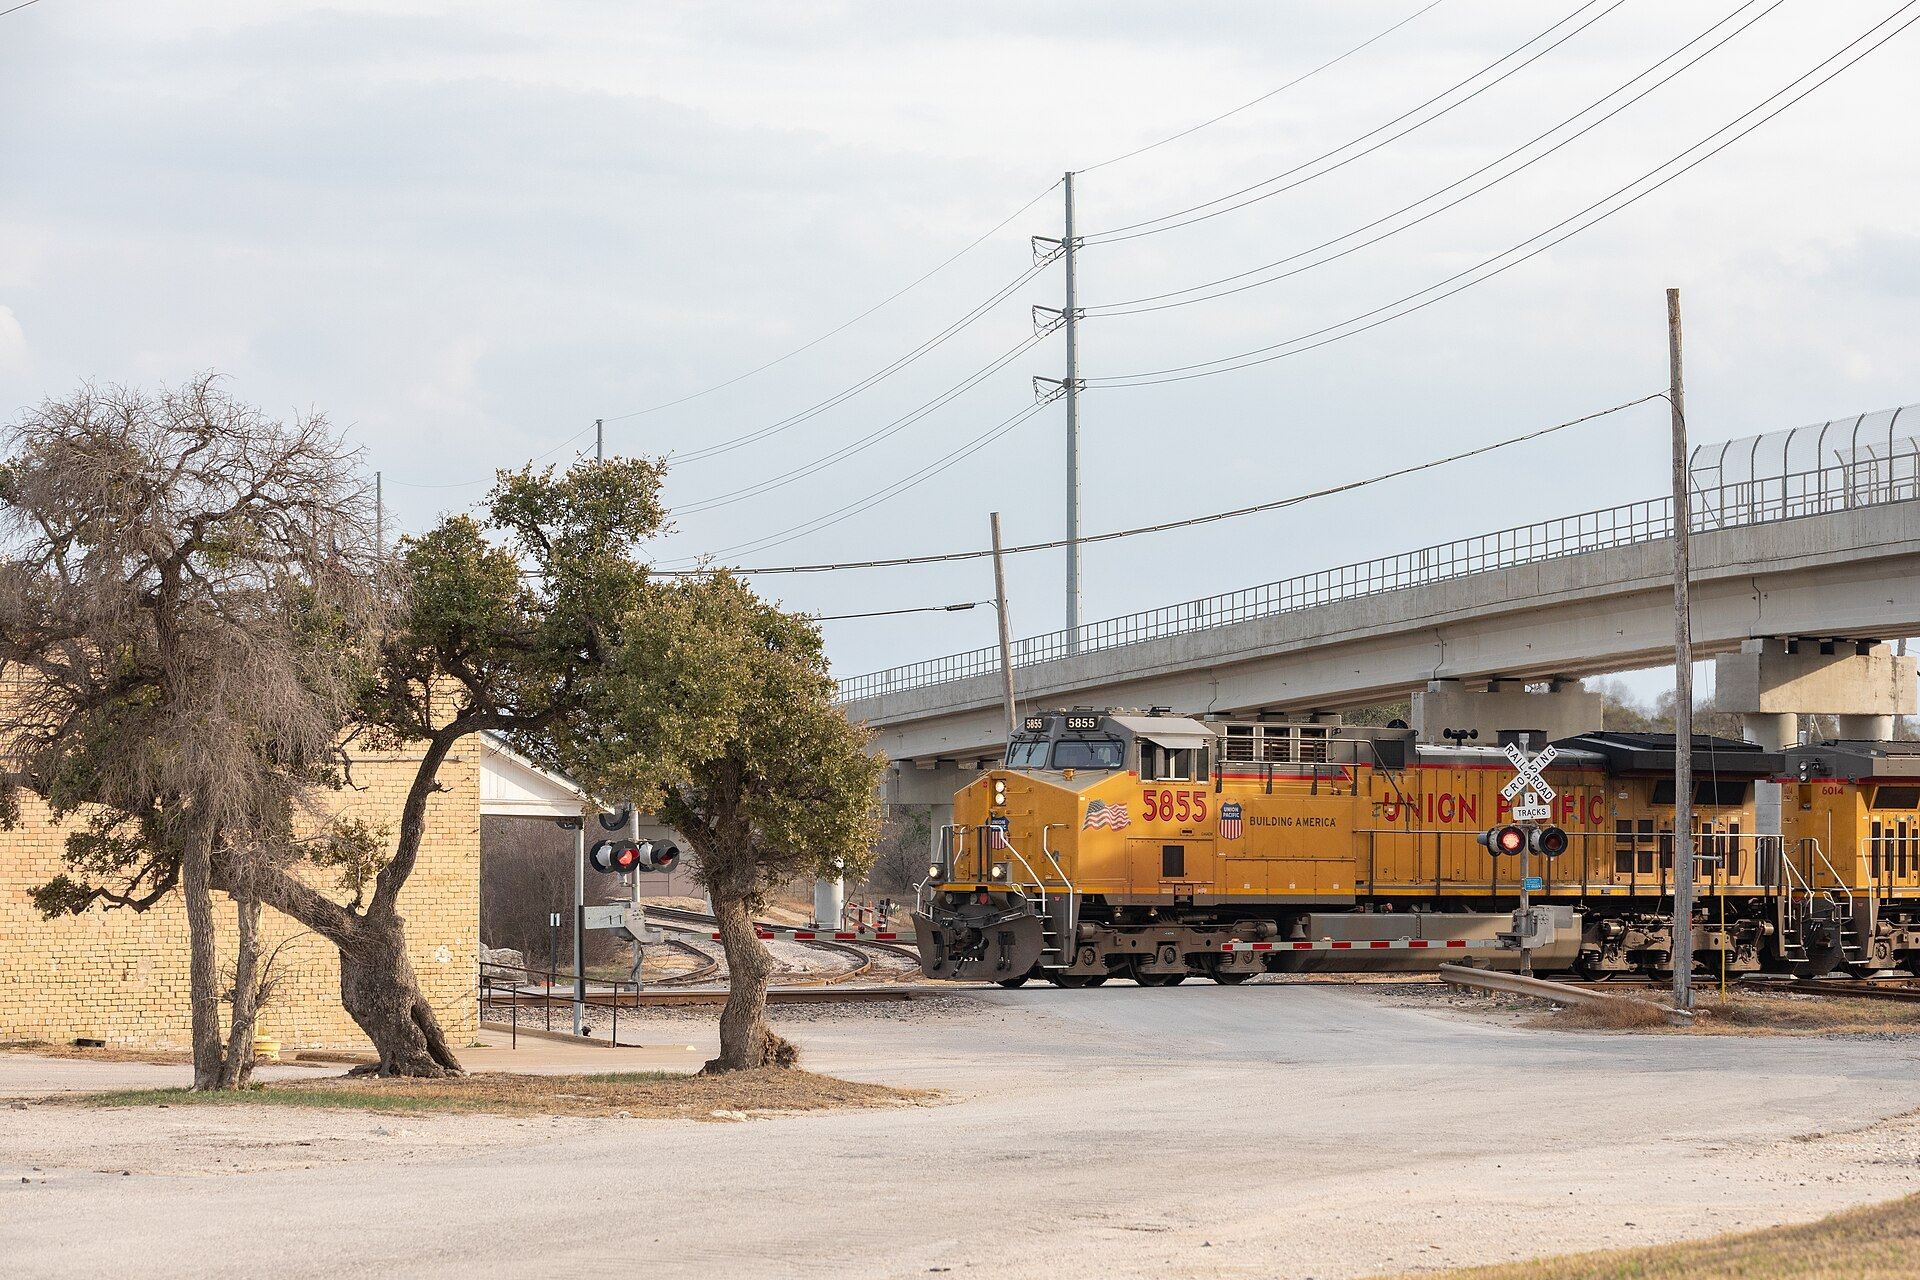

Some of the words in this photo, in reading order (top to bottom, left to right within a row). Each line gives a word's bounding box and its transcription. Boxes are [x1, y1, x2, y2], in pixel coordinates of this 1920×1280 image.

[1026, 718, 1043, 729] 5855
[1068, 717, 1096, 728] 5855
[1504, 748, 1556, 798] CROSSING
[1821, 786, 1844, 795] 6014
[1528, 794, 1535, 804] 3
[1142, 789, 1207, 822] 5855
[1382, 791, 1477, 824] UNION
[1496, 793, 1604, 825] PIFIC
[1517, 808, 1547, 817] TRACKS
[1249, 816, 1293, 827] BUILDING
[1295, 817, 1336, 827] AMERICA
